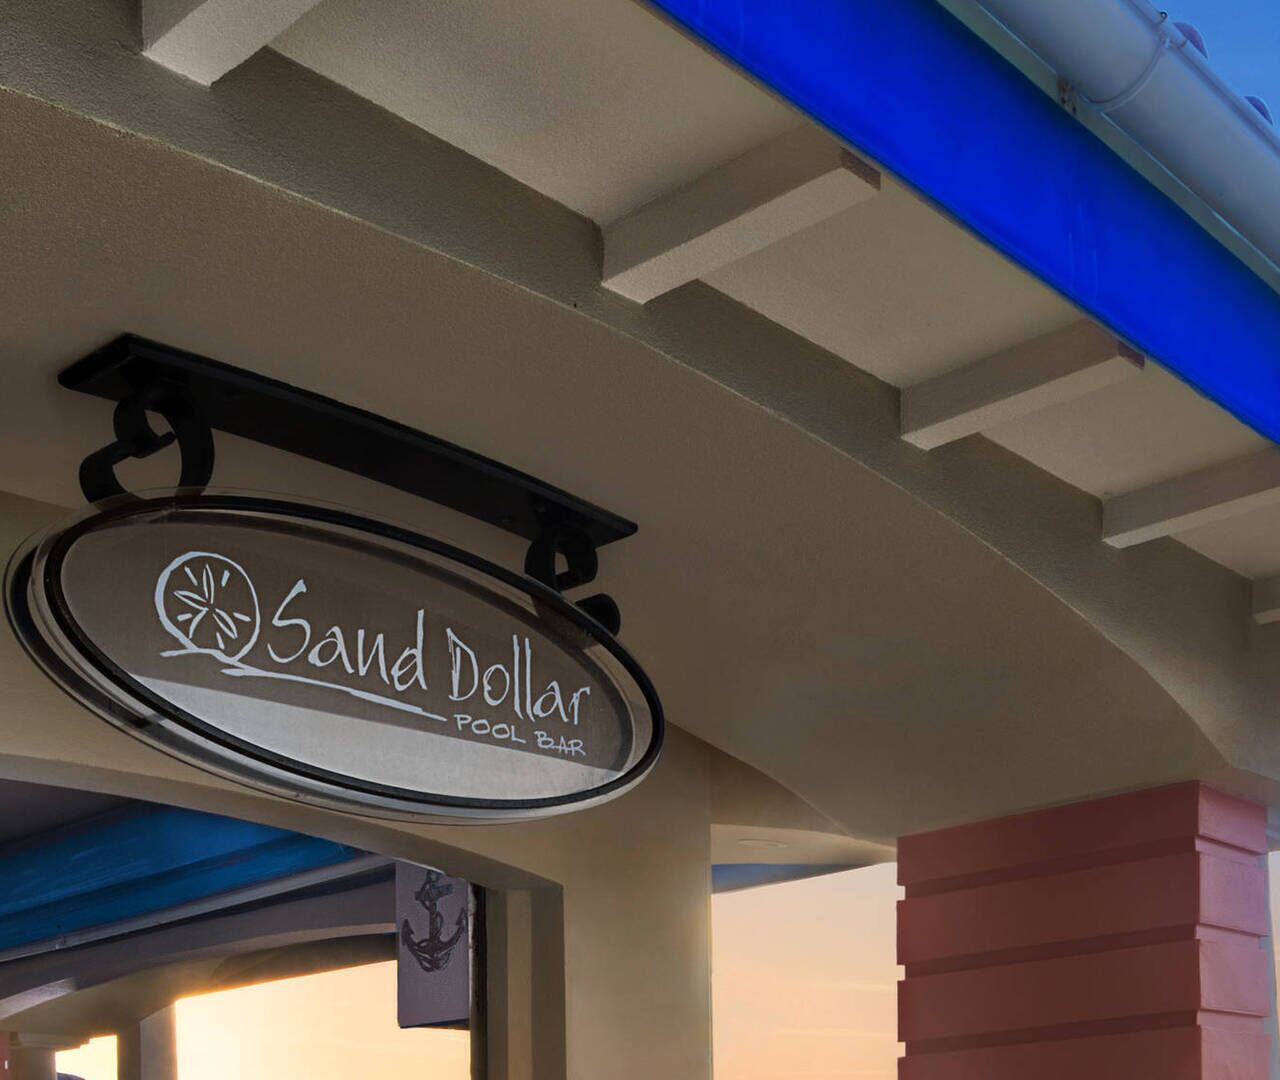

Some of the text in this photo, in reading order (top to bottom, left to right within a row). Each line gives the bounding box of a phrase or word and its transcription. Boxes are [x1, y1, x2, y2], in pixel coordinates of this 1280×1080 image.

[267, 579, 590, 725] Sand Dollar
[453, 714, 586, 756] POOL BAR
